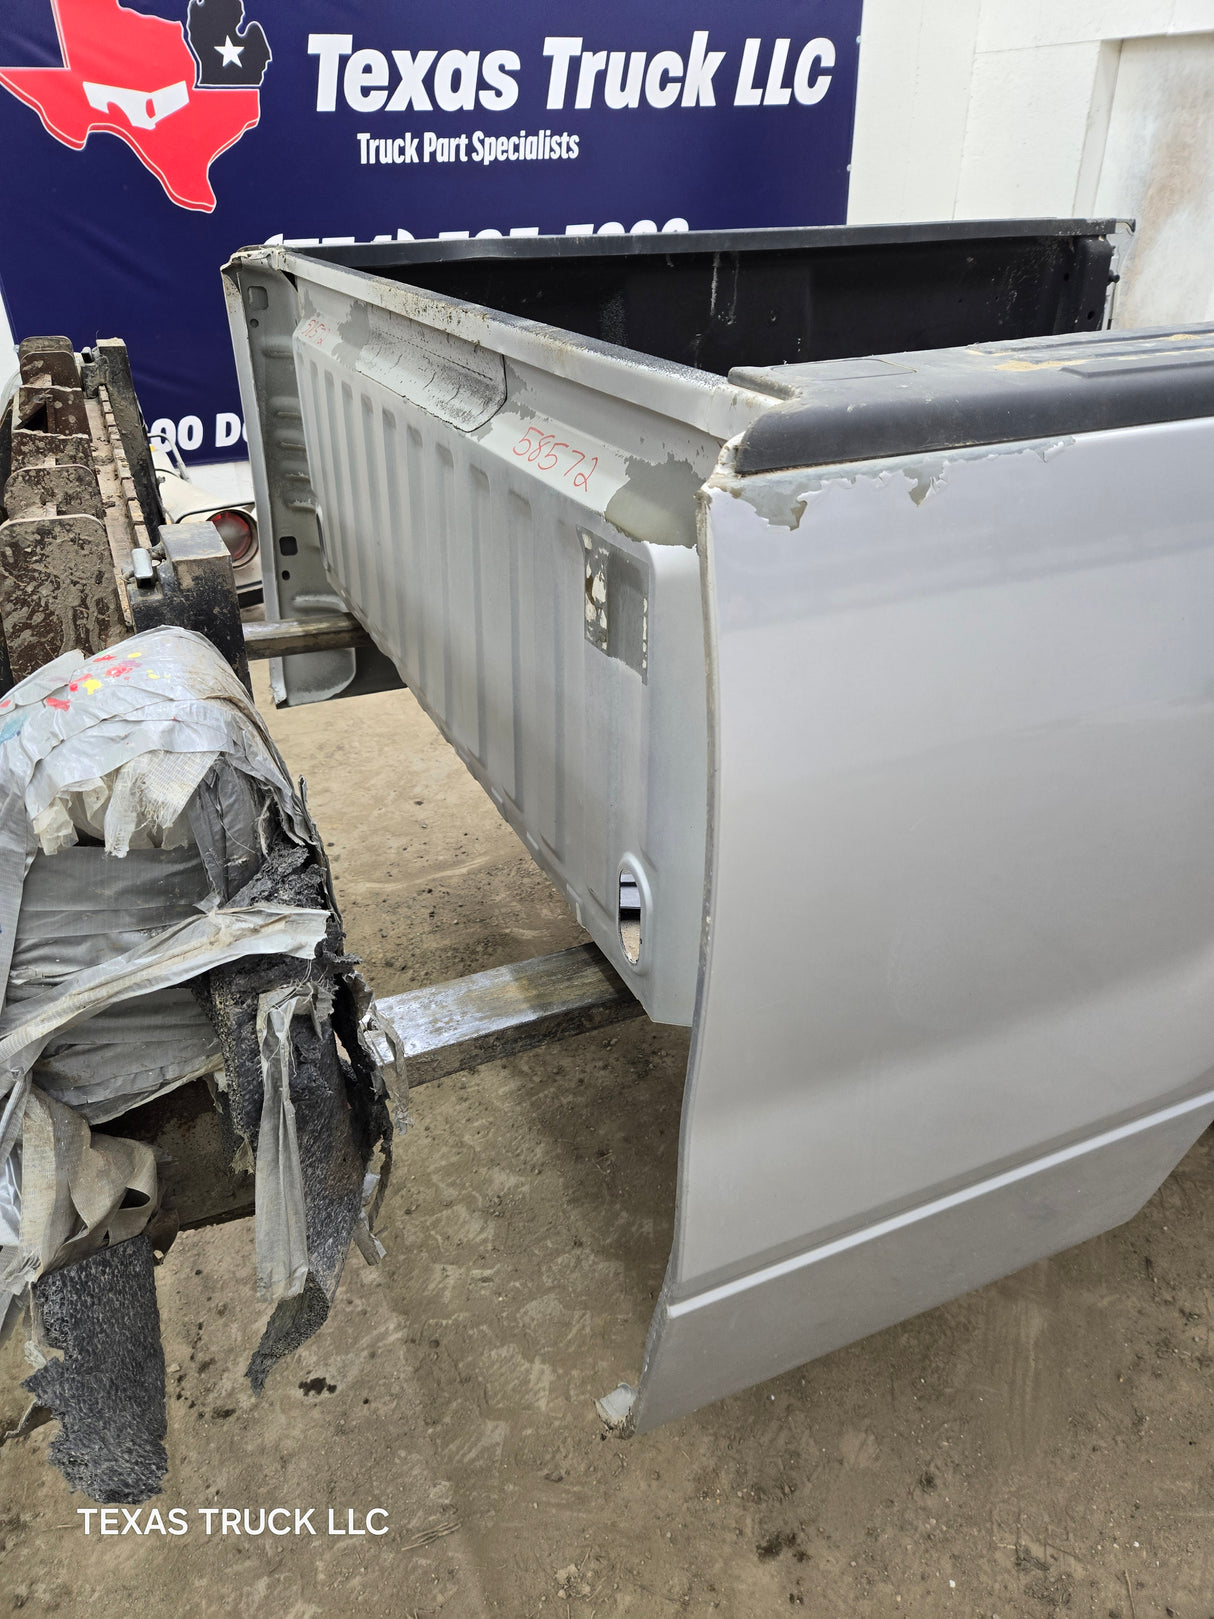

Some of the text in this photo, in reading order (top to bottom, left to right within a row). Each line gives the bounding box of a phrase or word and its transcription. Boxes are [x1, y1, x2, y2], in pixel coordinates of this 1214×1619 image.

[307, 30, 836, 112] Texas Truck LLC
[357, 129, 580, 165] Truck Part Specialists
[512, 426, 599, 492] 58572
